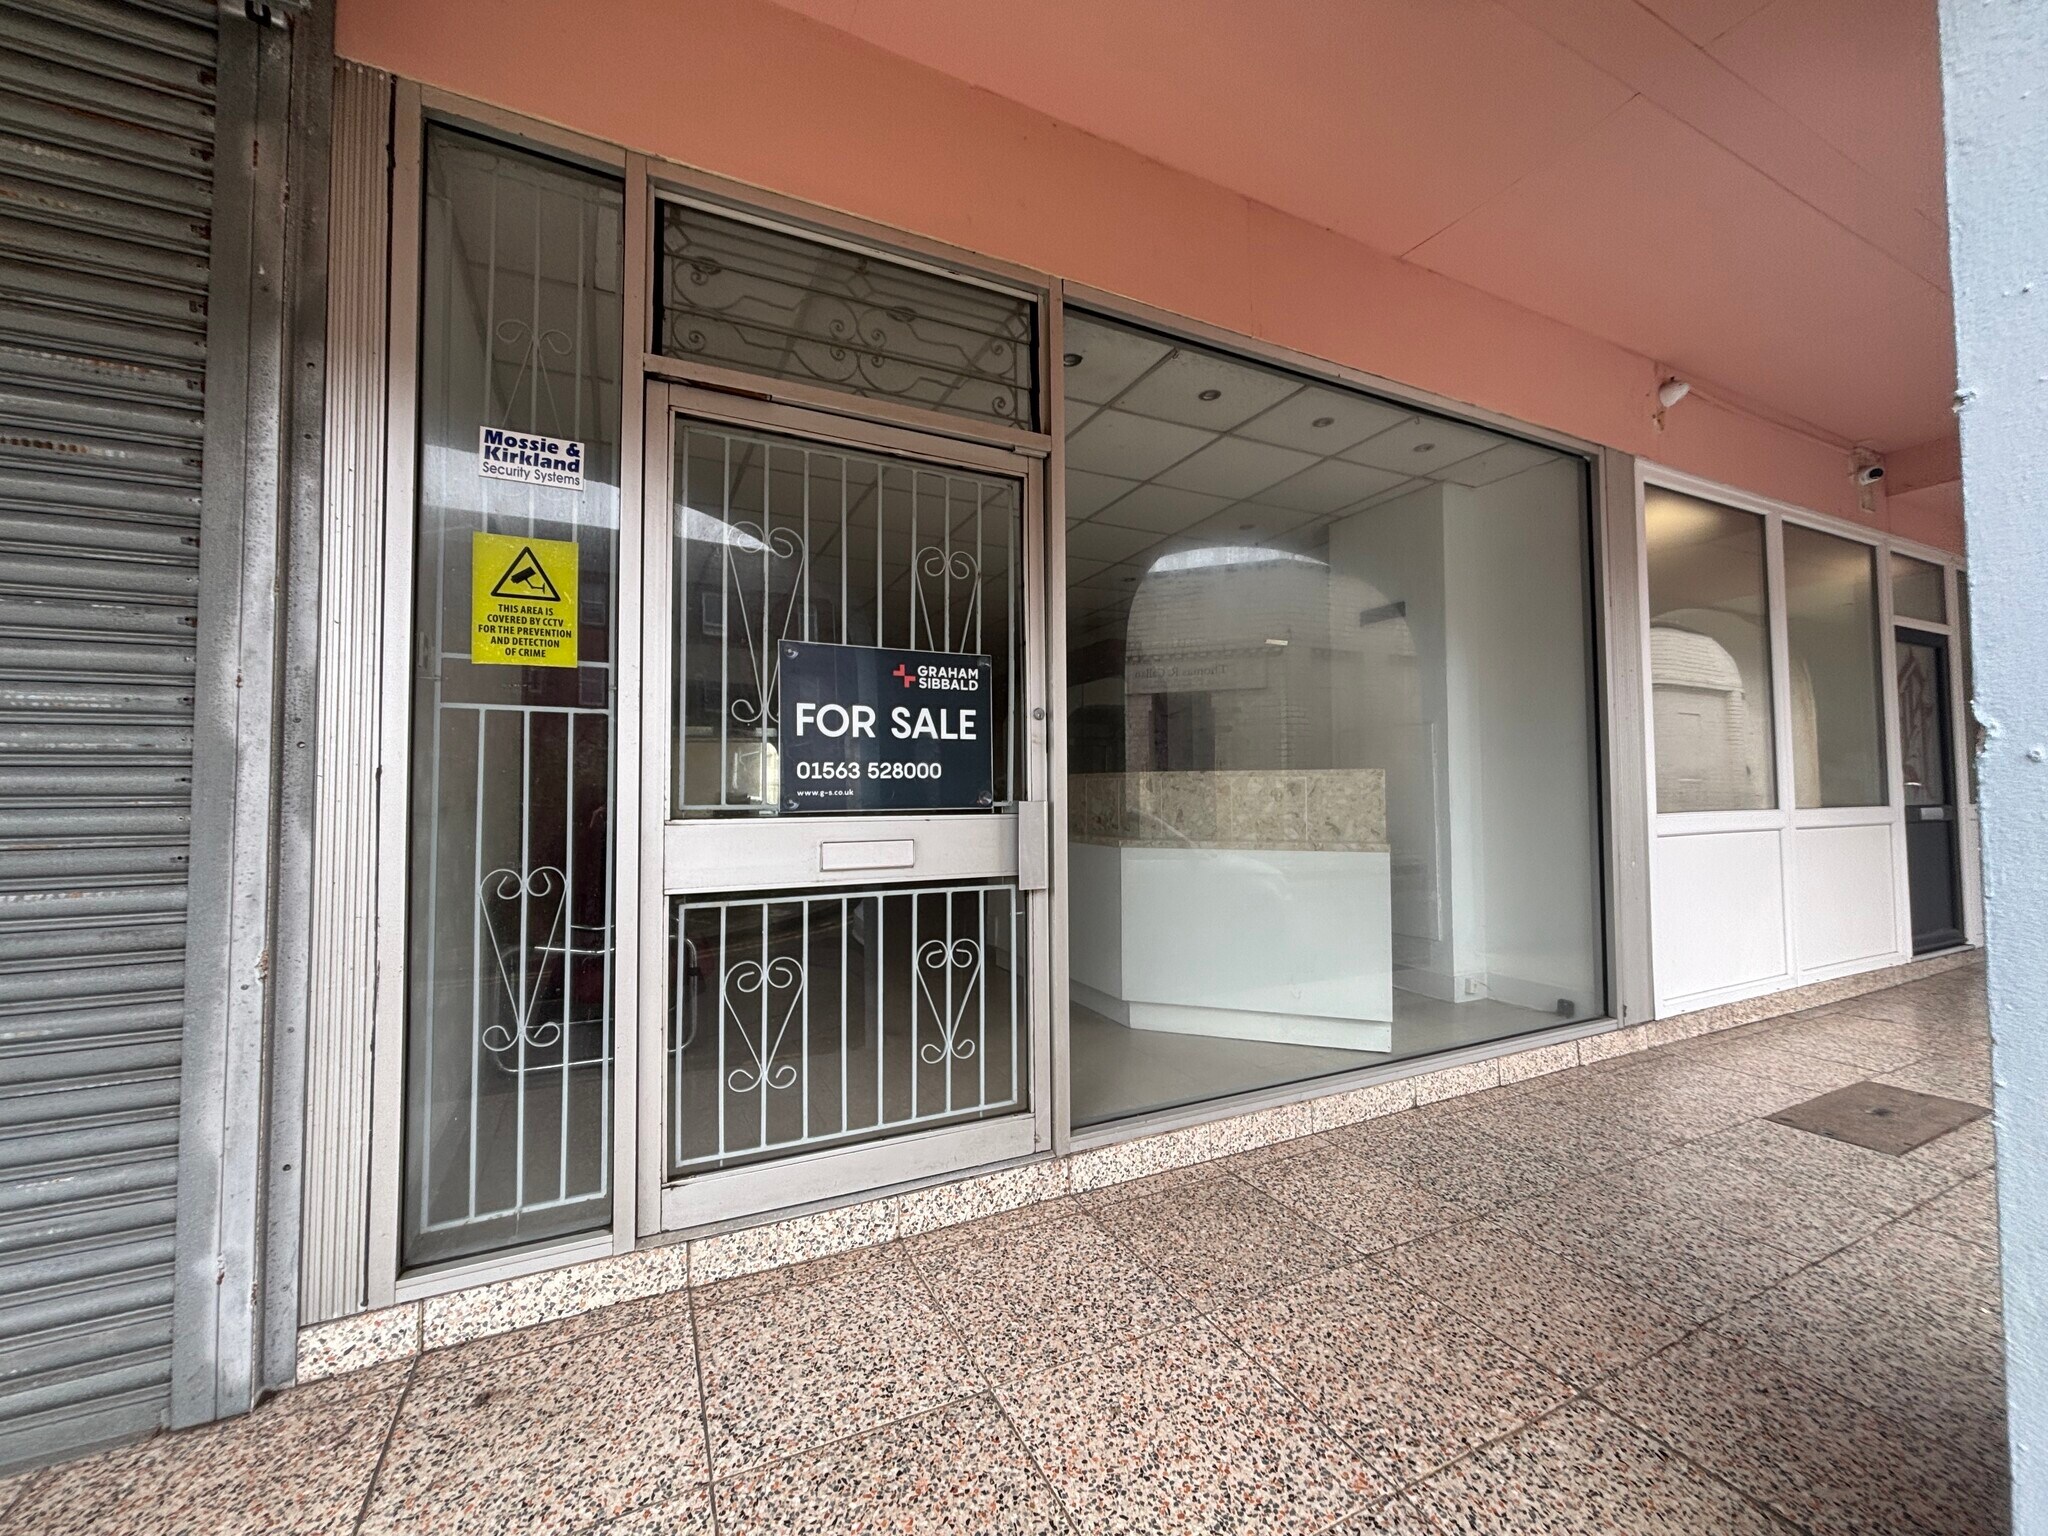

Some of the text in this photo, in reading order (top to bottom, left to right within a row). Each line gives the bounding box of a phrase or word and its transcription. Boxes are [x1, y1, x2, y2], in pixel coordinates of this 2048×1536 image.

[484, 429, 580, 458] Mossie &
[484, 445, 580, 473] Kirkland
[482, 461, 580, 486] Security Systems
[498, 603, 554, 616] THIS AREA IS
[487, 613, 564, 628] COVERED BY CCTV
[478, 624, 572, 639] FOR THE PREVENTION
[490, 636, 560, 648] AND DETECTION
[505, 647, 546, 658] OF CRIME
[917, 665, 979, 680] GRAHAM
[918, 677, 979, 691] SIBBALD
[796, 702, 977, 740] FOR SALE
[796, 761, 943, 780] 01563 528000
[796, 788, 854, 797] www.g-s.co.uk
